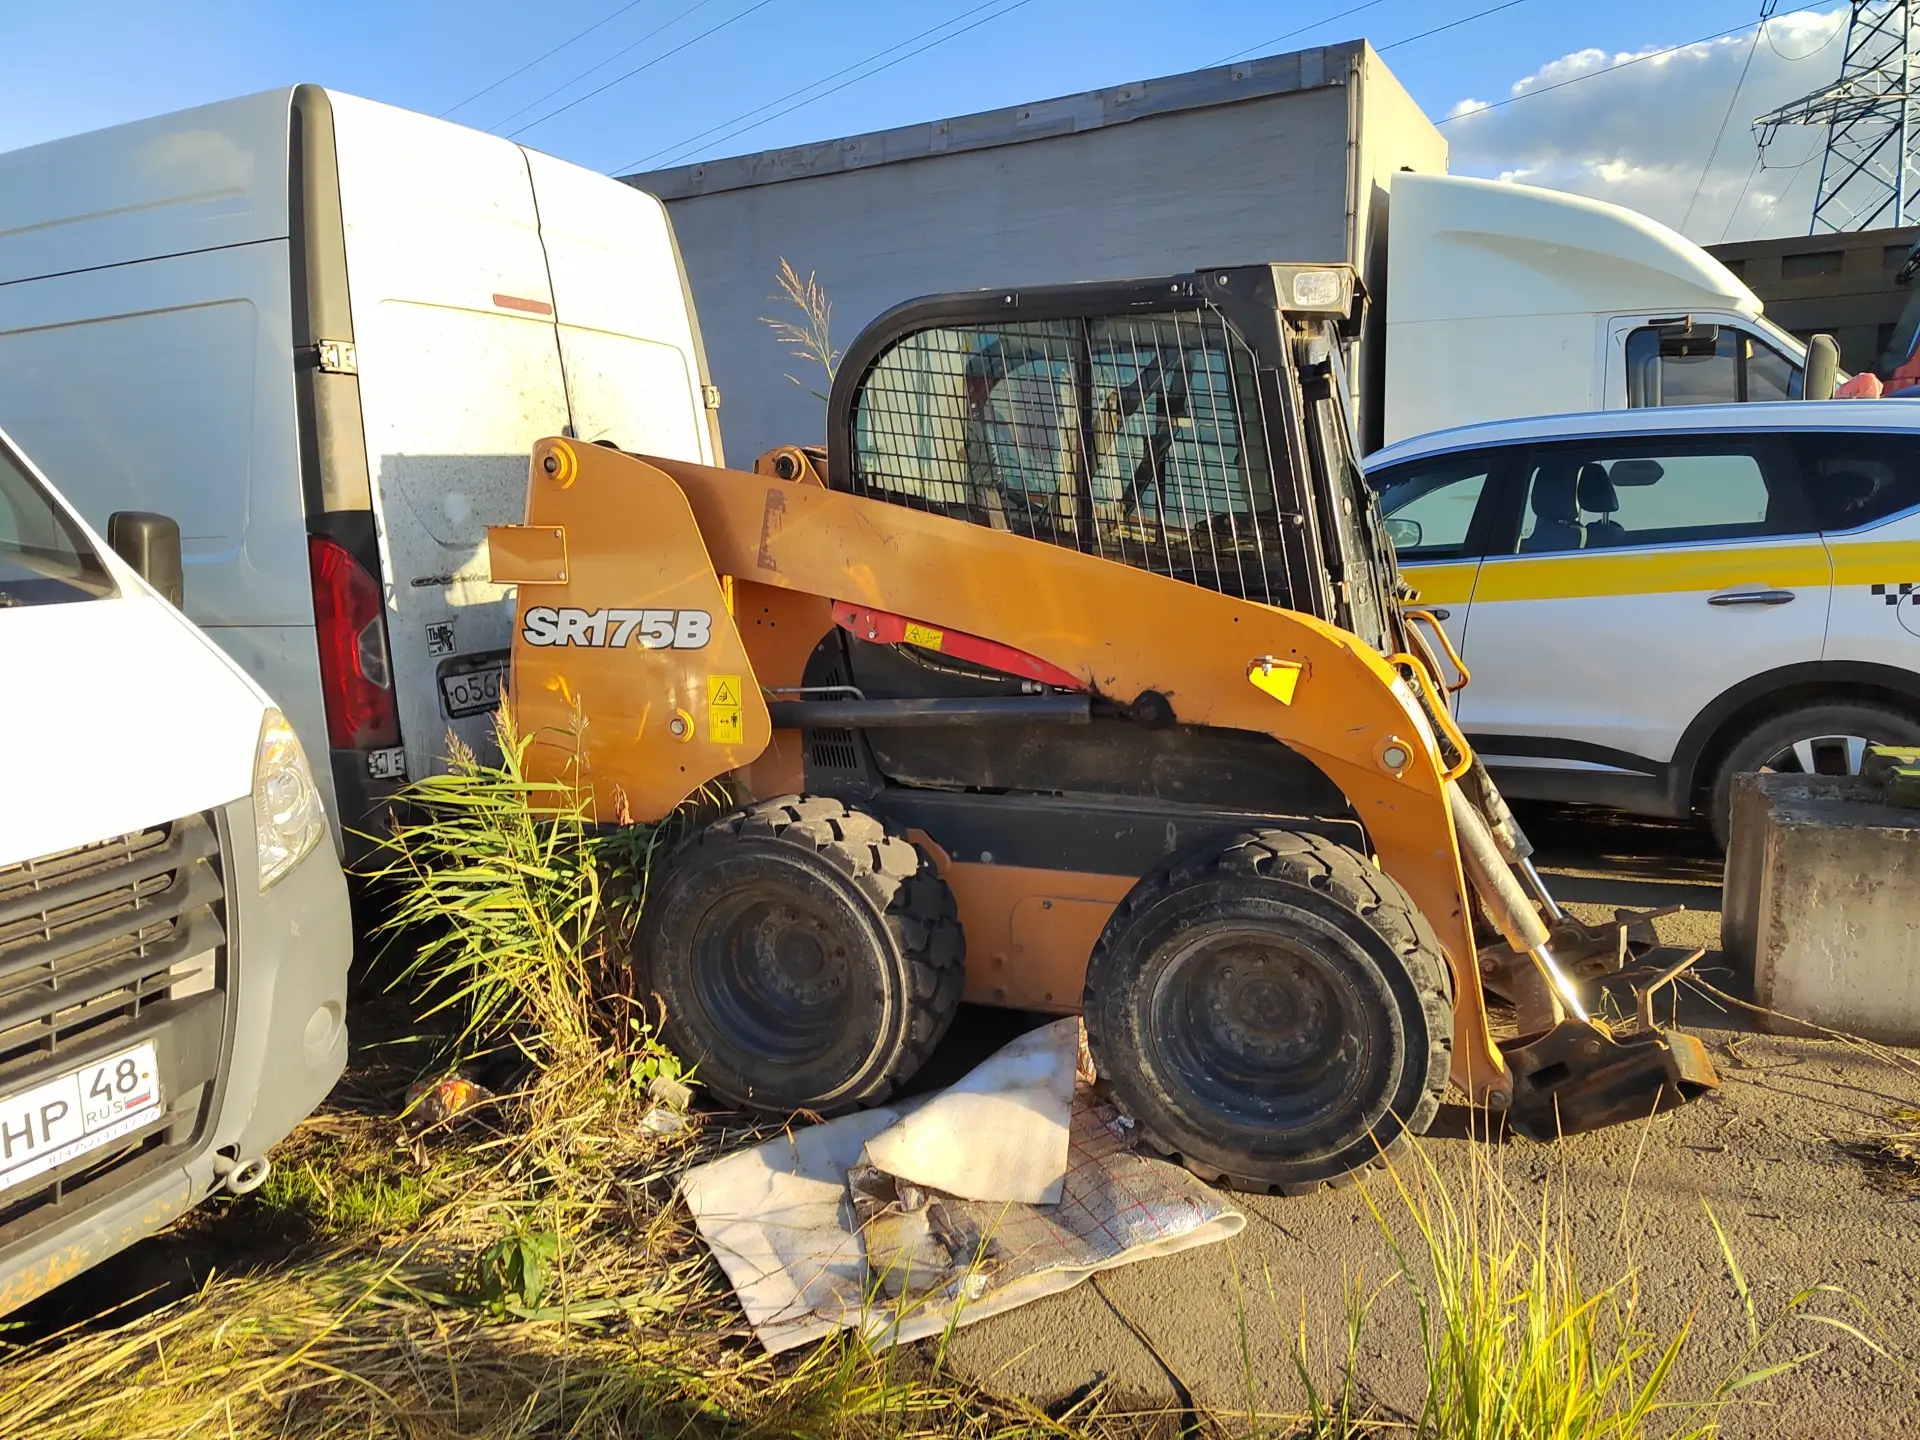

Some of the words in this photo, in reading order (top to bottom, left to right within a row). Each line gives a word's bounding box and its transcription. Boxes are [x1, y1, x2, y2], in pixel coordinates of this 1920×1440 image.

[522, 607, 712, 650] SR175B
[89, 1058, 139, 1101] 48
[86, 1101, 124, 1127] RUS
